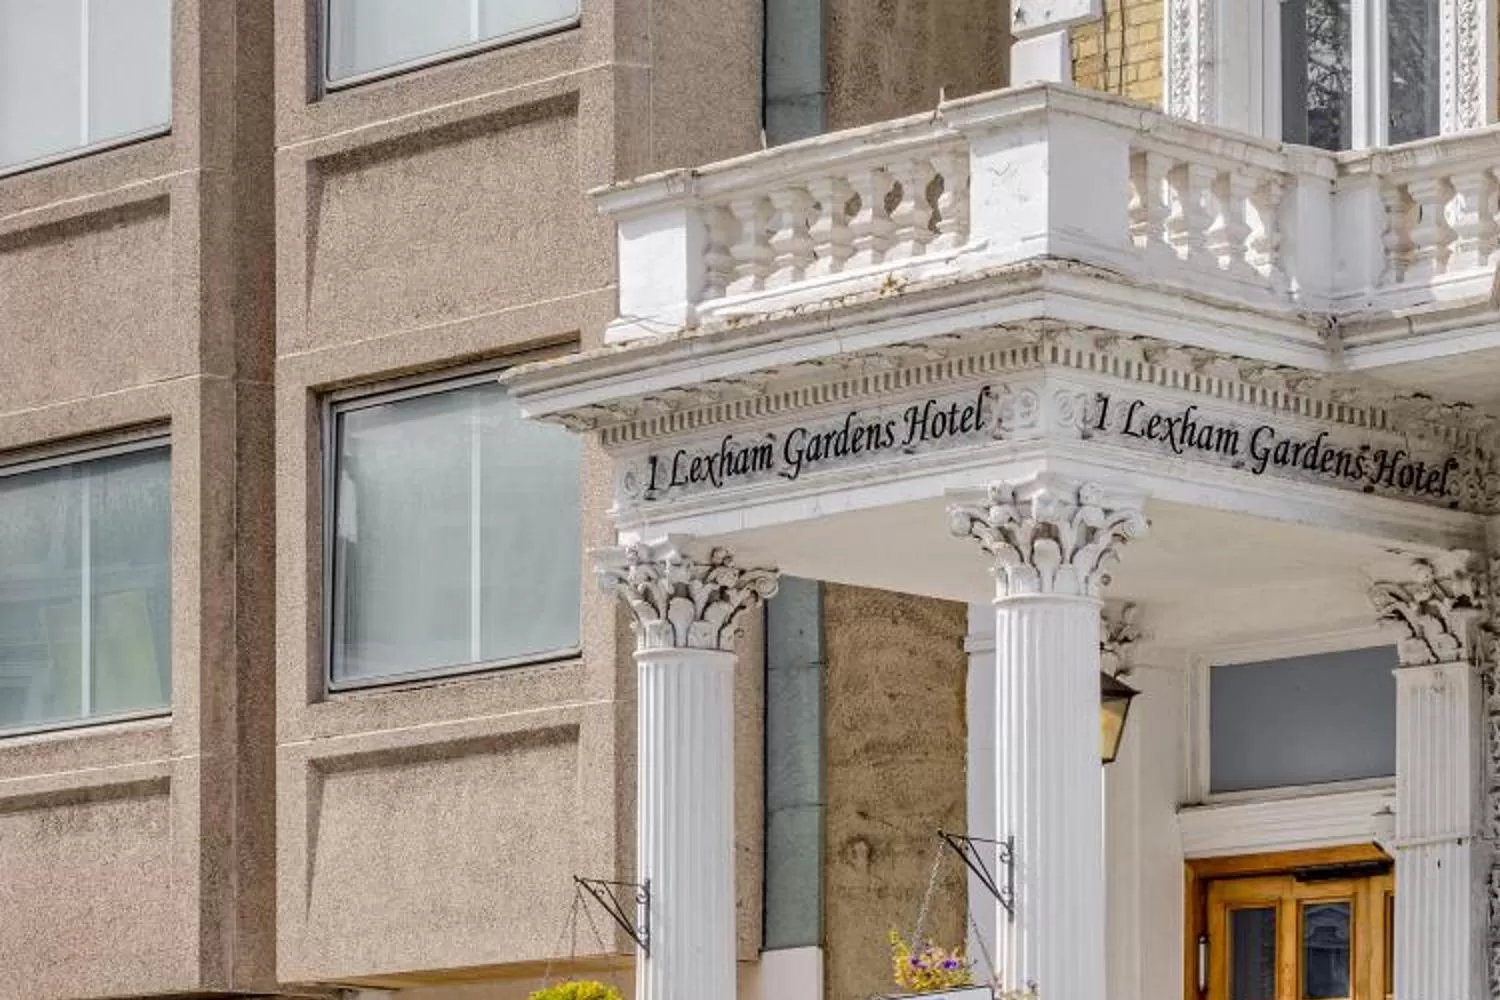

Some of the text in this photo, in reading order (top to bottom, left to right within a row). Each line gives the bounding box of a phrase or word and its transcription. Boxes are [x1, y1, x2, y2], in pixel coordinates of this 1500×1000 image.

[647, 384, 991, 491] 1 Lexham Gardens Hotel
[1094, 393, 1456, 497] 1 Lexham Gardens Hotel
